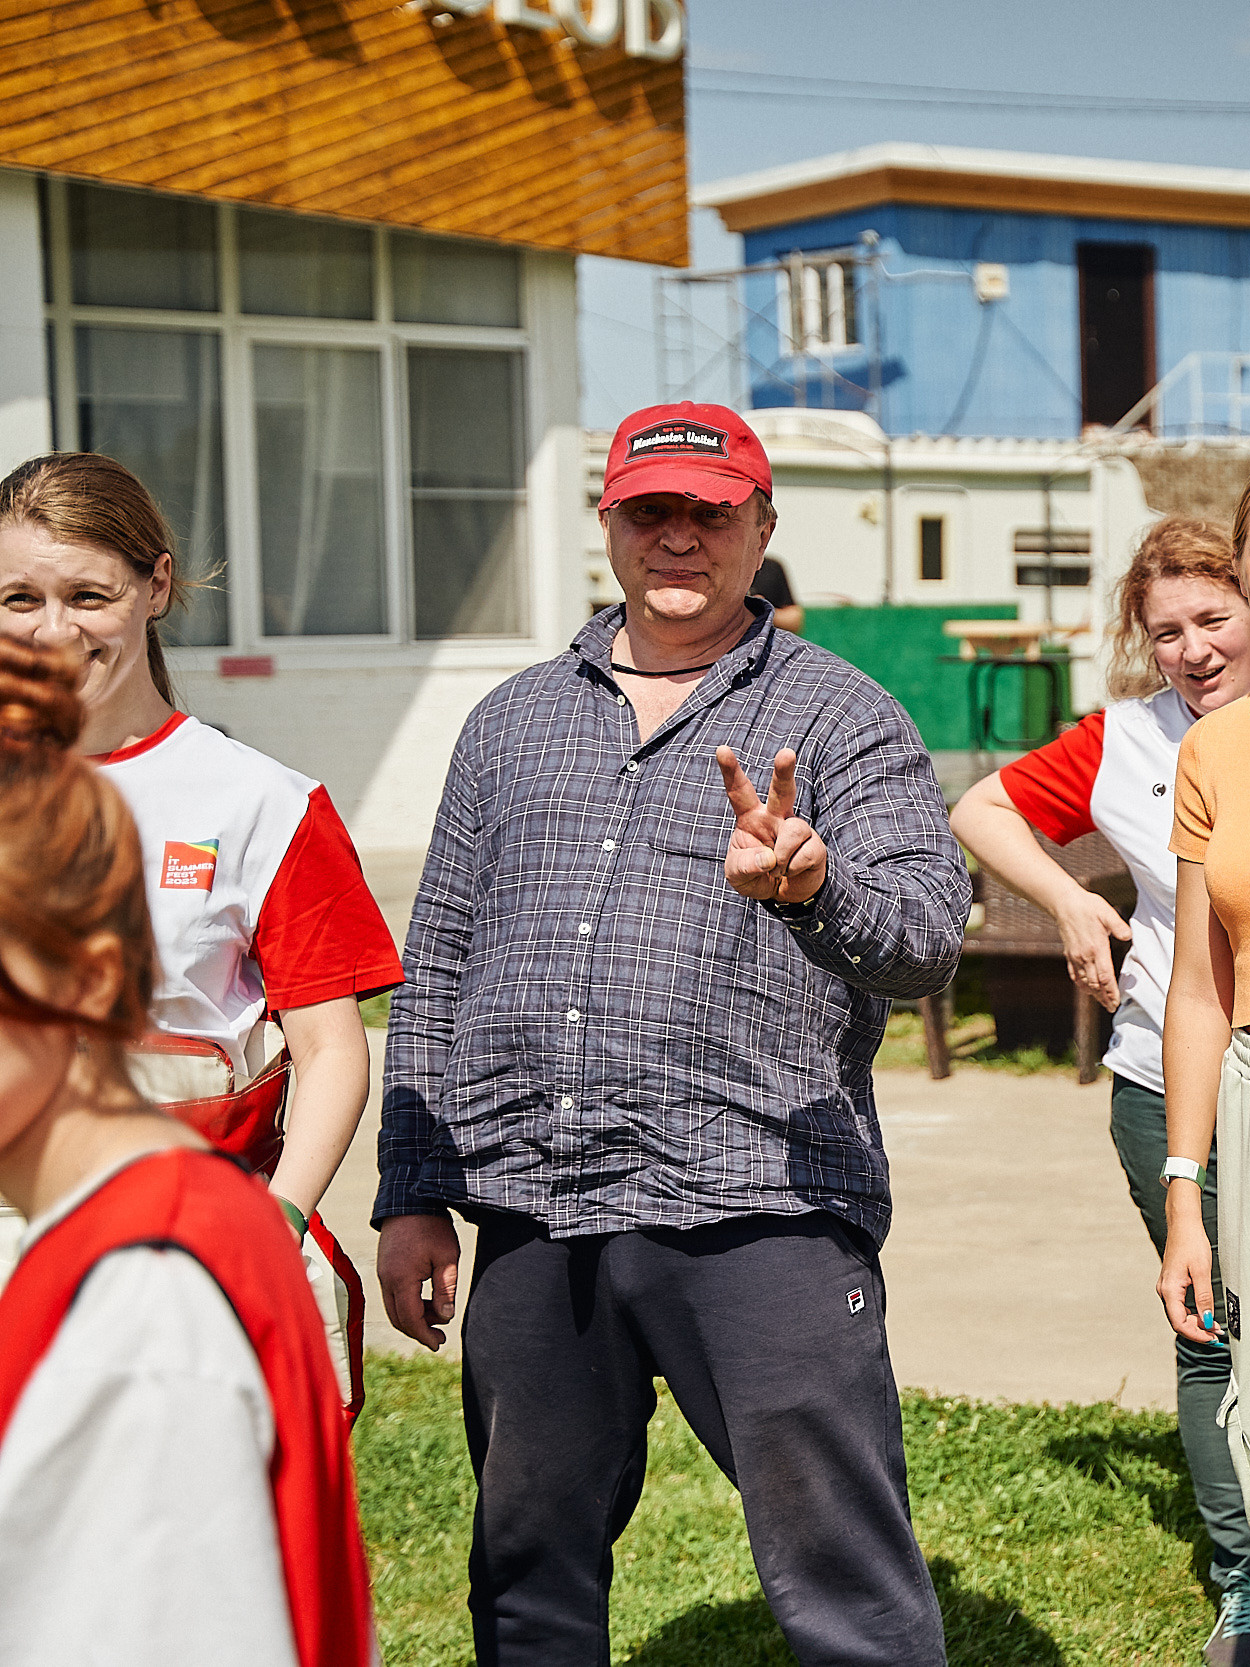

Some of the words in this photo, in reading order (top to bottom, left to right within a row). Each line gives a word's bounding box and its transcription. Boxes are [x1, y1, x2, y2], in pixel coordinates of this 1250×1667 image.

[632, 432, 685, 451] Manchester
[686, 431, 719, 447] United
[167, 862, 215, 872] SUMMER
[165, 877, 198, 885] 2023
